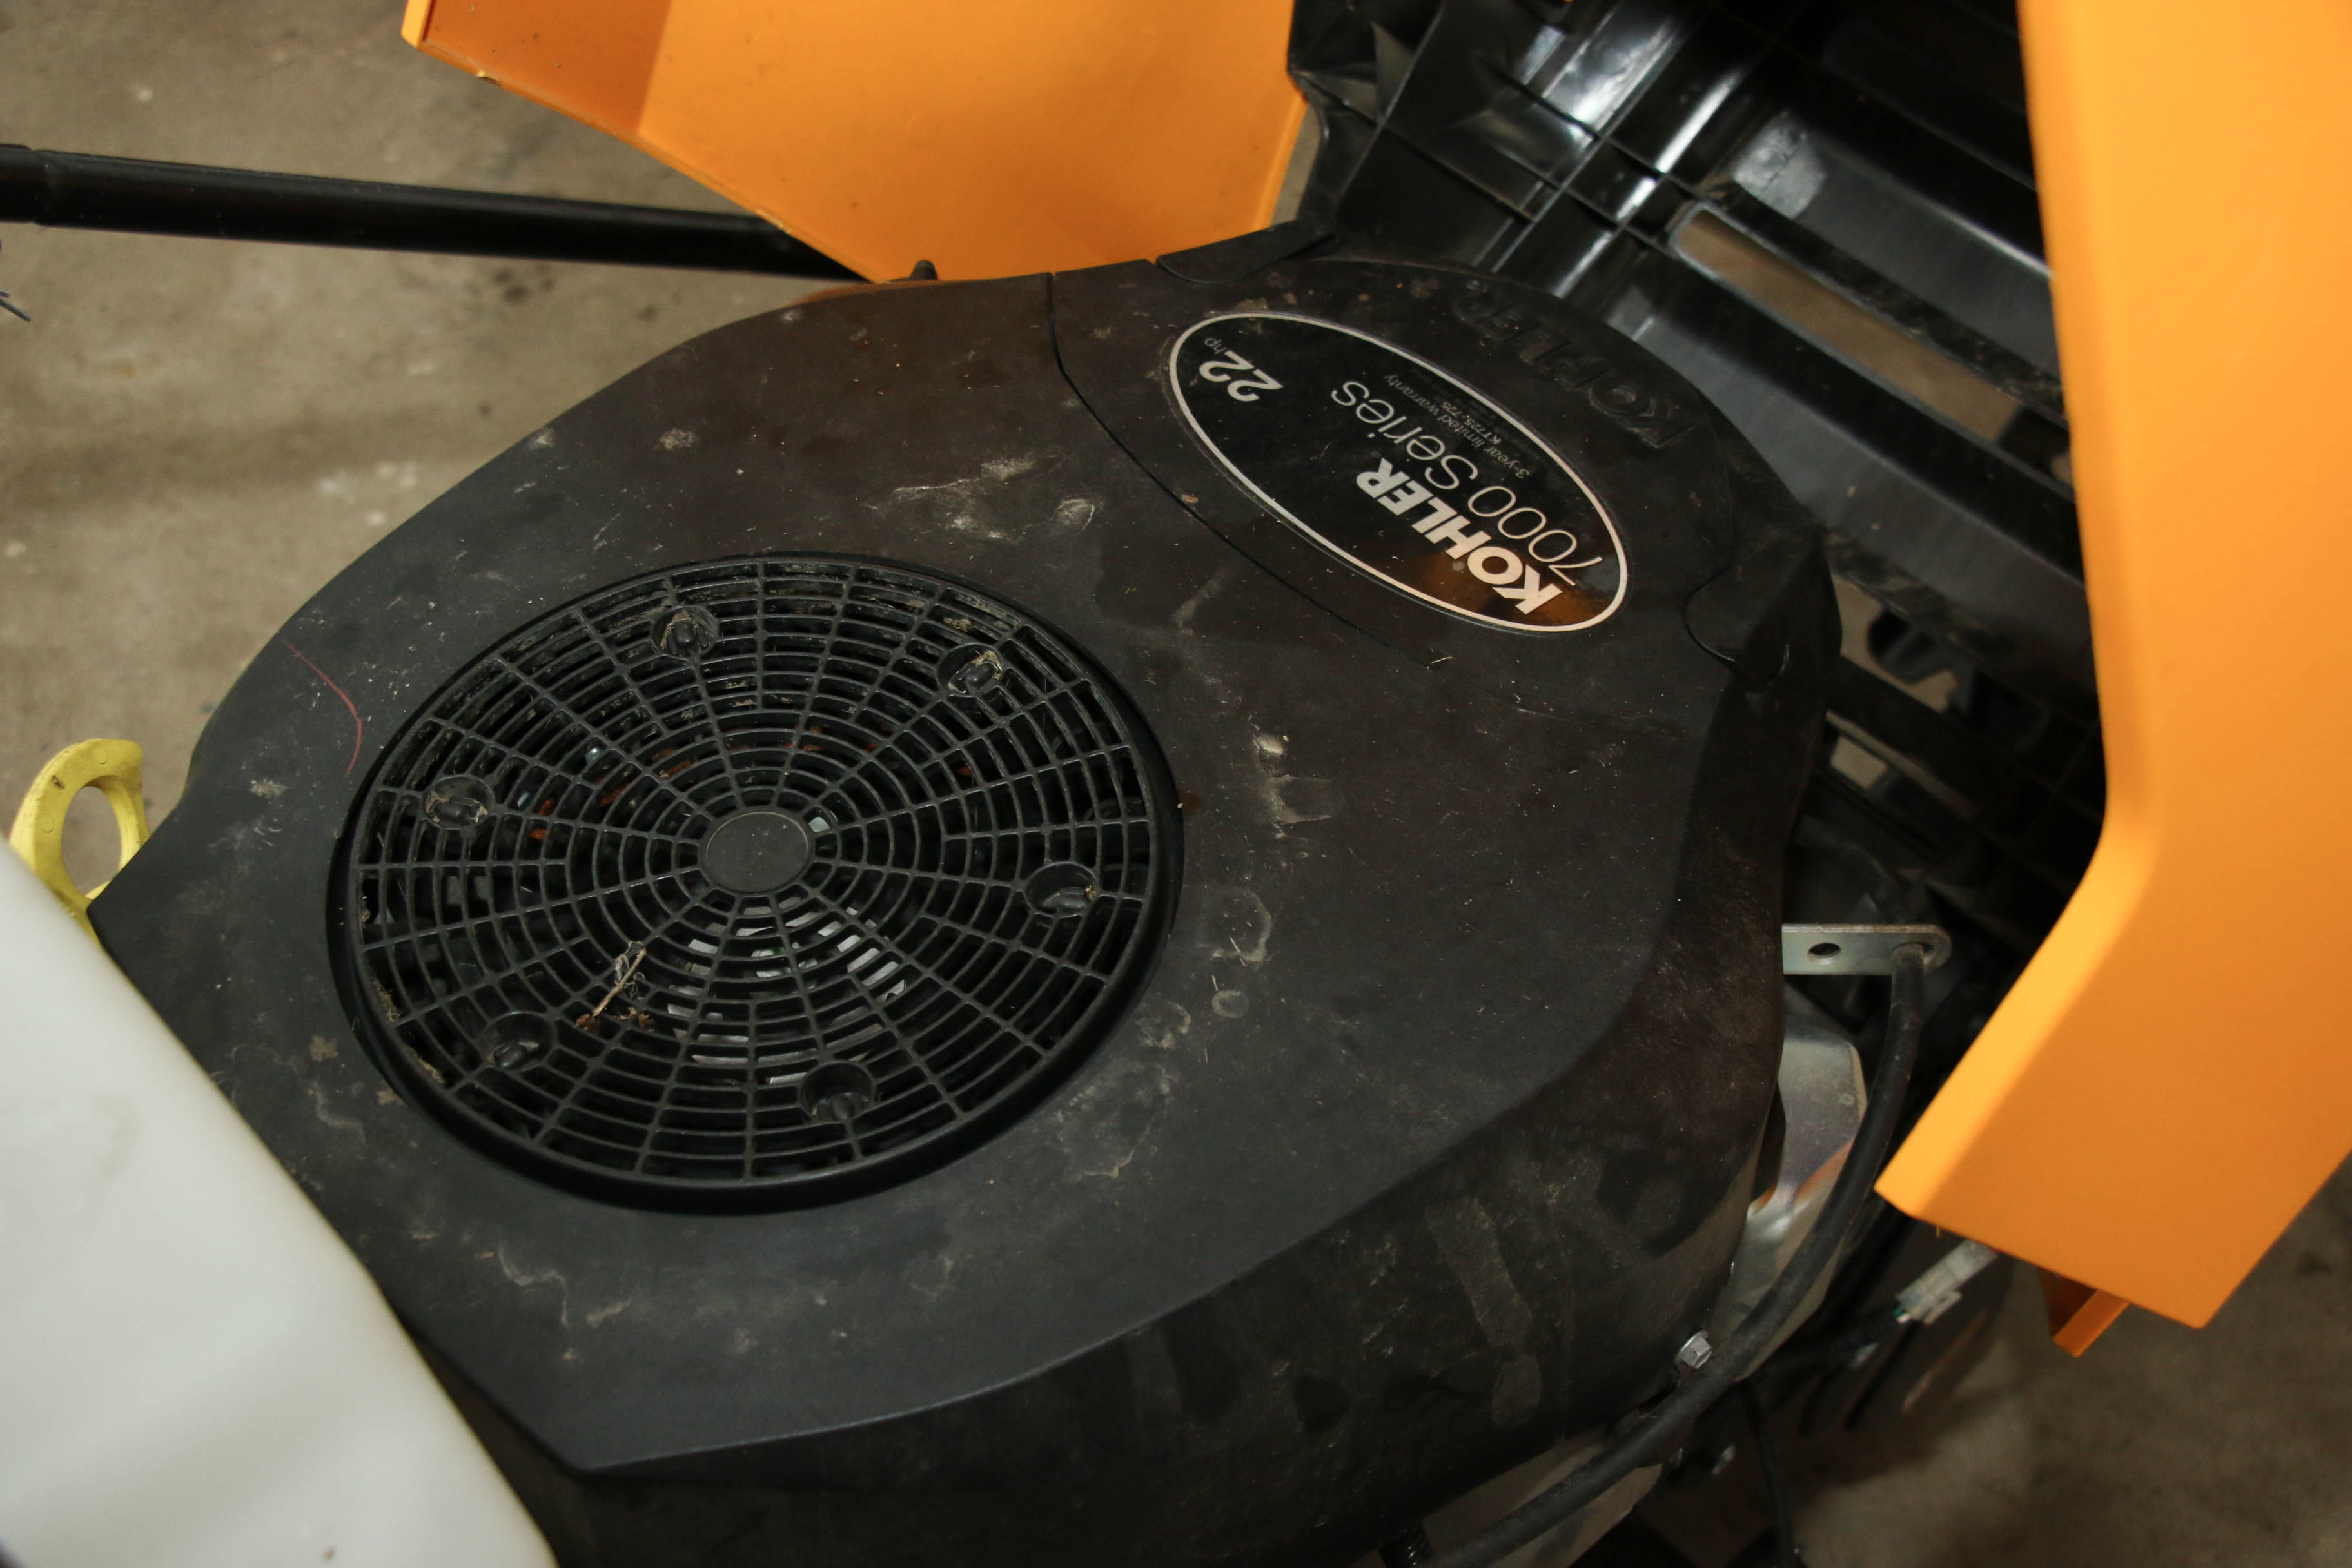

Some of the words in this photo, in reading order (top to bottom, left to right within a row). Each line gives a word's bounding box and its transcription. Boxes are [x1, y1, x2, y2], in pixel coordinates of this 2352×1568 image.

[1204, 338, 1227, 355] hp
[1199, 350, 1284, 402] 22
[1383, 374, 1440, 416] warranty
[1331, 380, 1478, 490] Series
[1436, 414, 1486, 448] limited
[1484, 446, 1529, 478] 3-year
[1356, 457, 1563, 614] KOHLER
[1467, 485, 1603, 586] 7000
